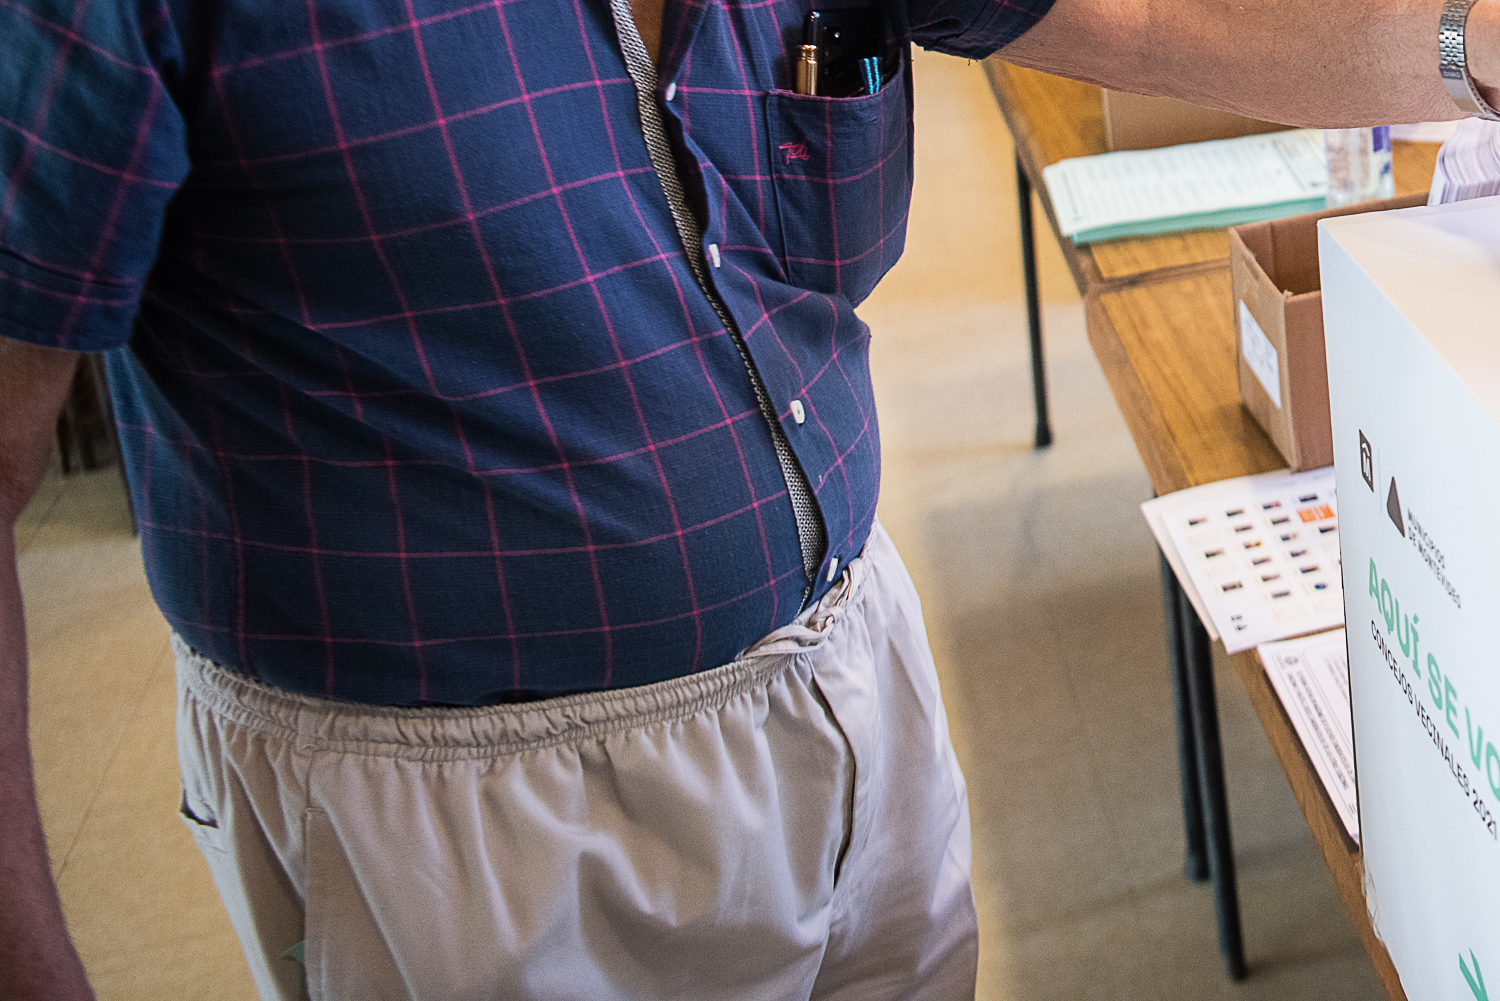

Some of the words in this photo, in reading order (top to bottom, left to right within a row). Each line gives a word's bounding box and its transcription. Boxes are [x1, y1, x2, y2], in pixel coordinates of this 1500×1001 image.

[1369, 556, 1422, 680] AQUÍ
[1427, 652, 1461, 740] SE
[1371, 619, 1414, 706] CONCEJOS
[1413, 693, 1471, 798] VECINALES
[1472, 788, 1498, 841] 2021
